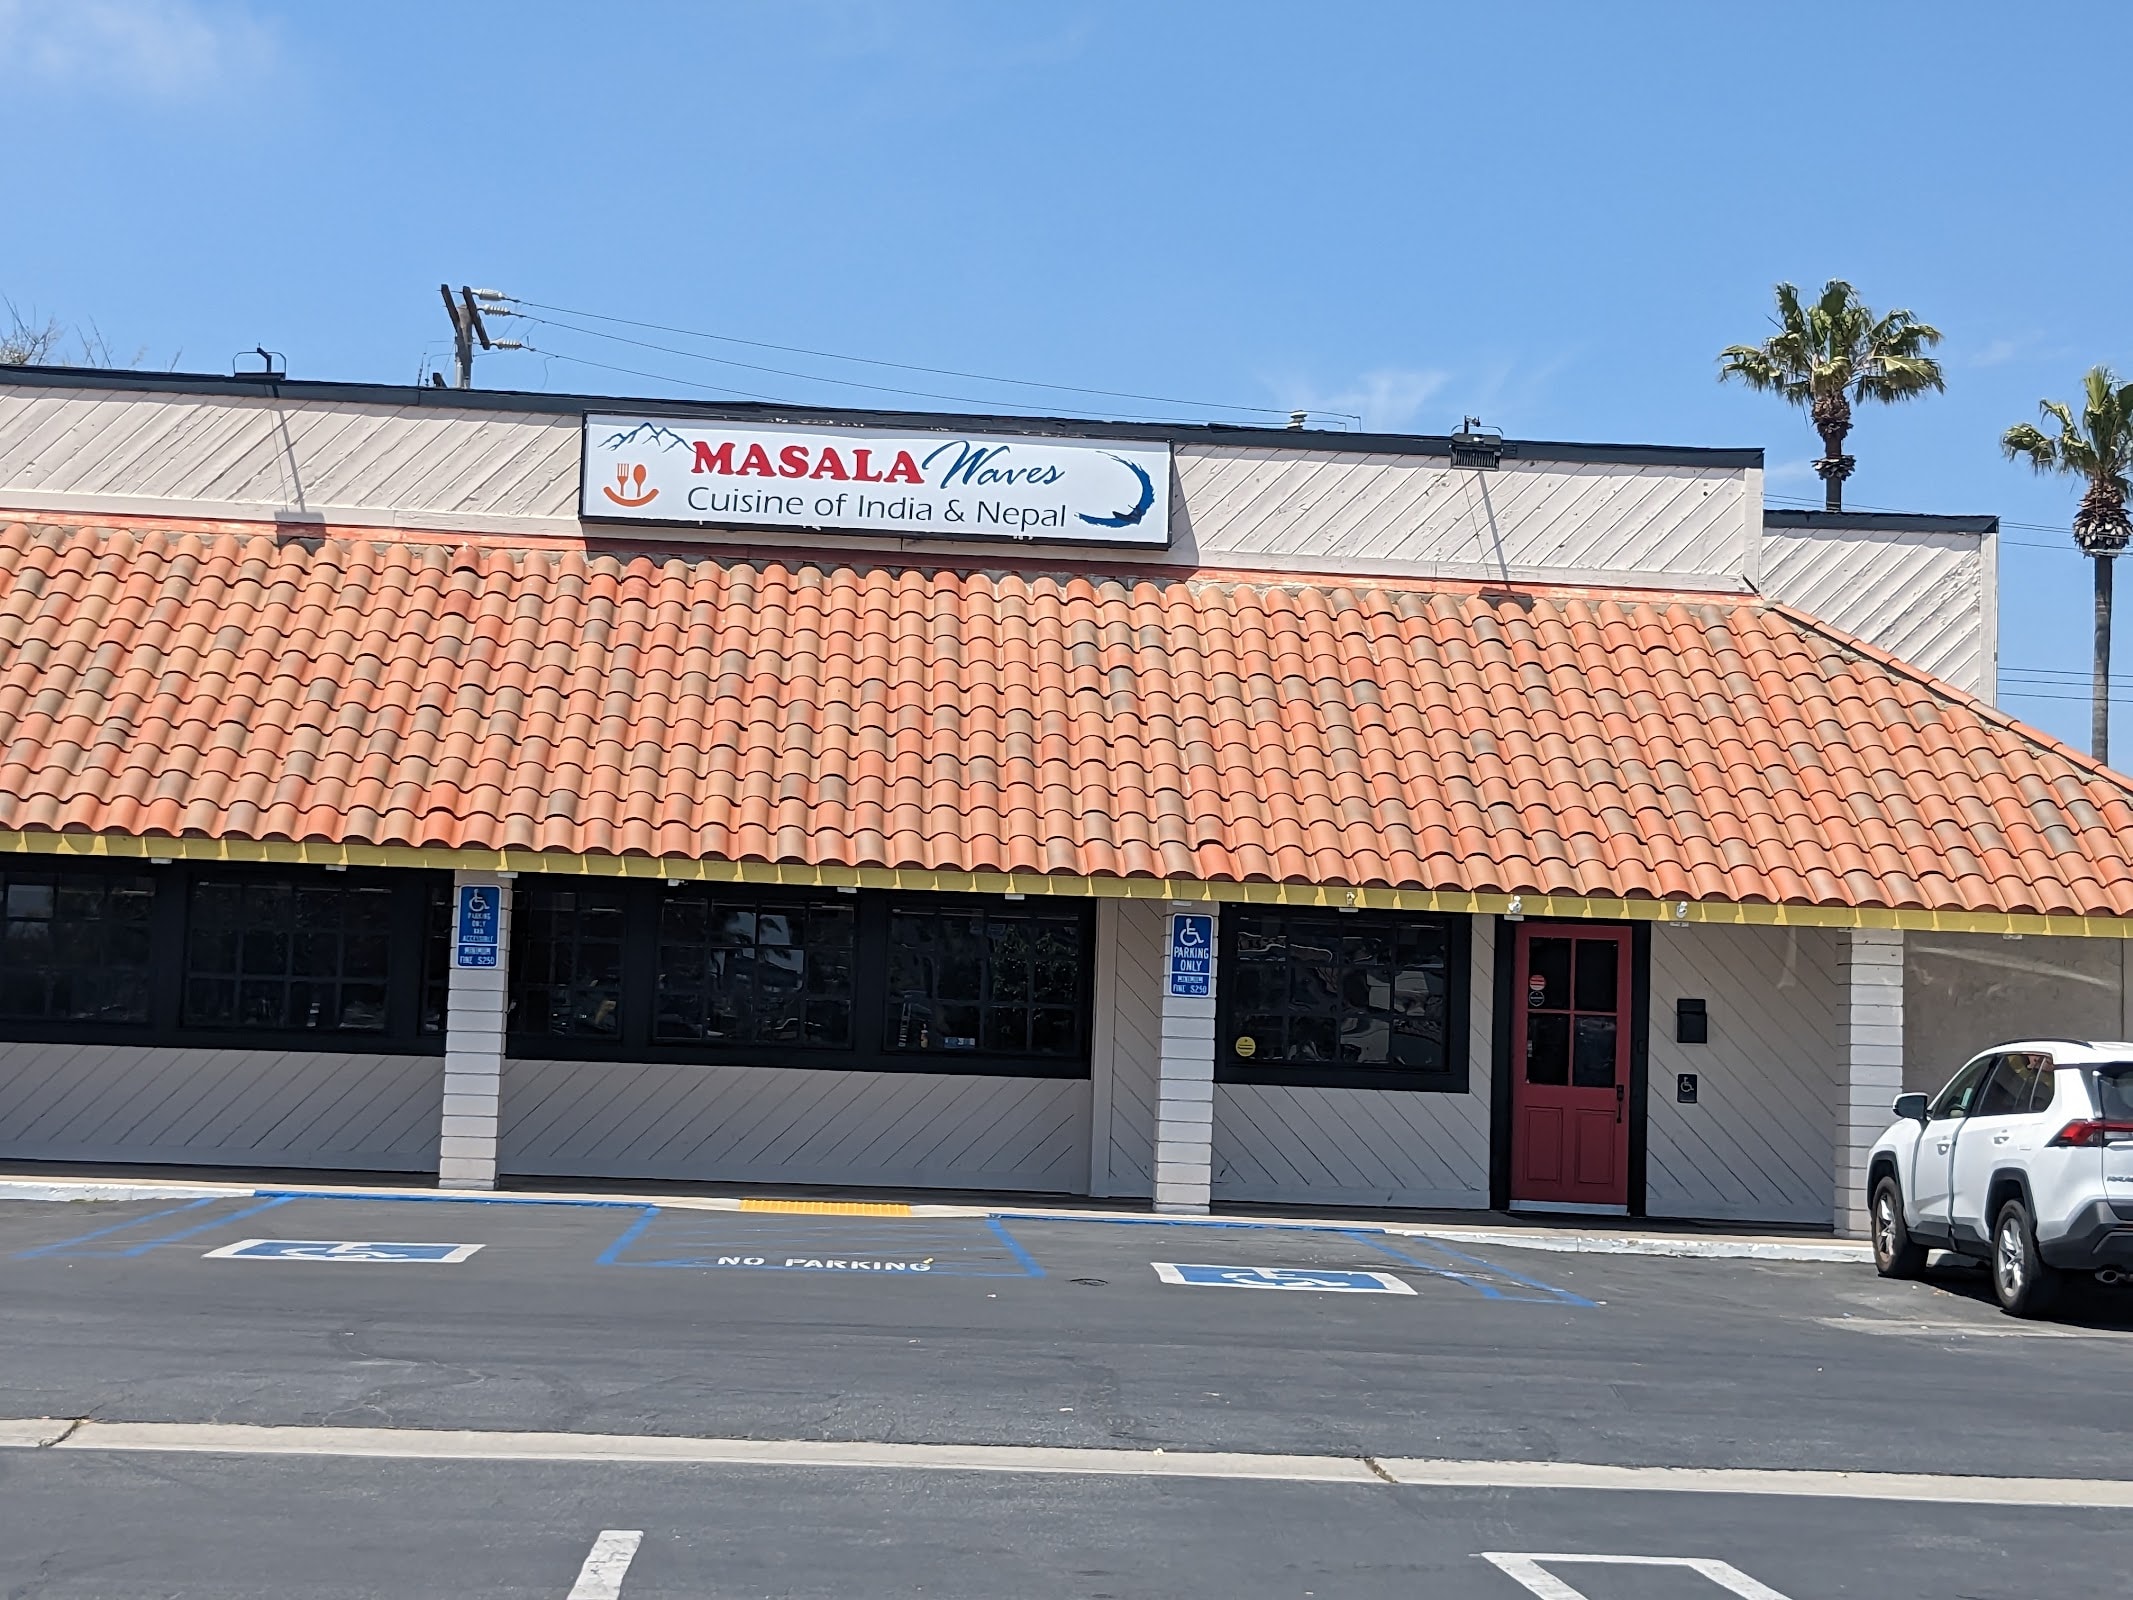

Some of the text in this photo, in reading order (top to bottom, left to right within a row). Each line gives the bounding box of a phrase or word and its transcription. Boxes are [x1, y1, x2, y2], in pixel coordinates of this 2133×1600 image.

[690, 440, 1066, 489] MASALA Waves
[687, 486, 1066, 532] Cuisine of India & Nepal
[1174, 946, 1209, 960] PARKING
[1180, 959, 1203, 972] ONLY
[717, 1256, 932, 1272] NO PARKING
